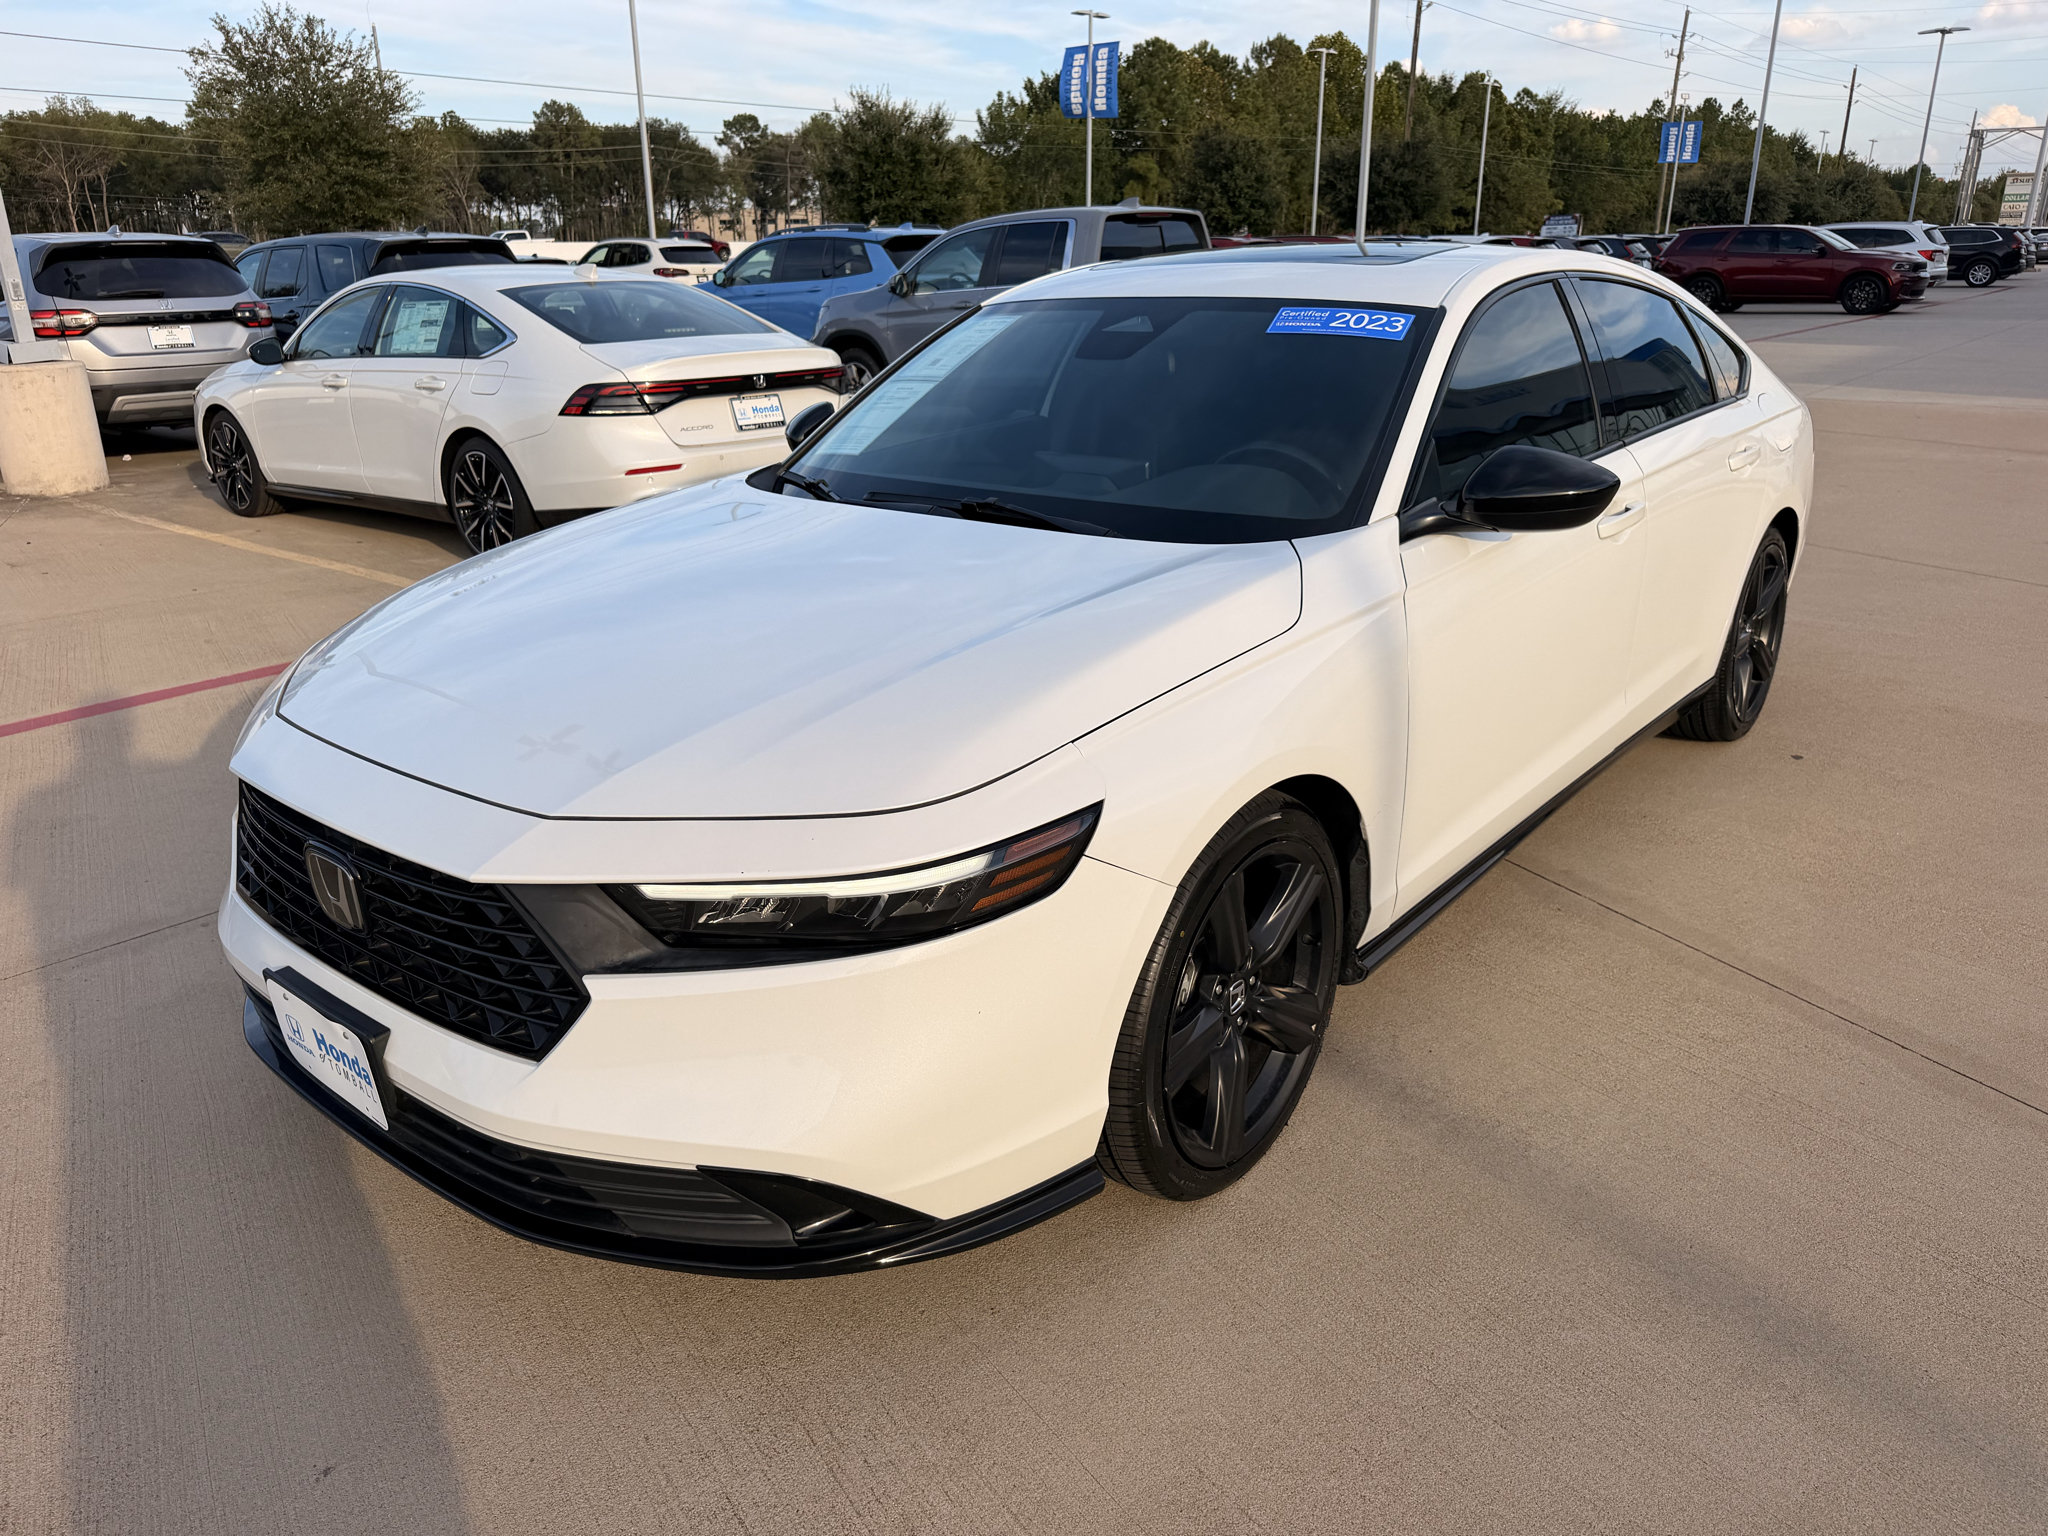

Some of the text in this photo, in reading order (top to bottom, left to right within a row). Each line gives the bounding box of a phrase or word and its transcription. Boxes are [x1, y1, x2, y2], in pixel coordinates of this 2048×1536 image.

[1071, 53, 1086, 115] Honda
[1094, 47, 1109, 111] Honda
[1666, 127, 1678, 161] Honda
[1682, 124, 1695, 159] Honda
[1329, 312, 1406, 333] 2023
[752, 404, 780, 415] Honda
[287, 1034, 316, 1058] HONDA
[312, 1028, 374, 1089] Honda
[319, 1053, 377, 1104] of TOMBALL
